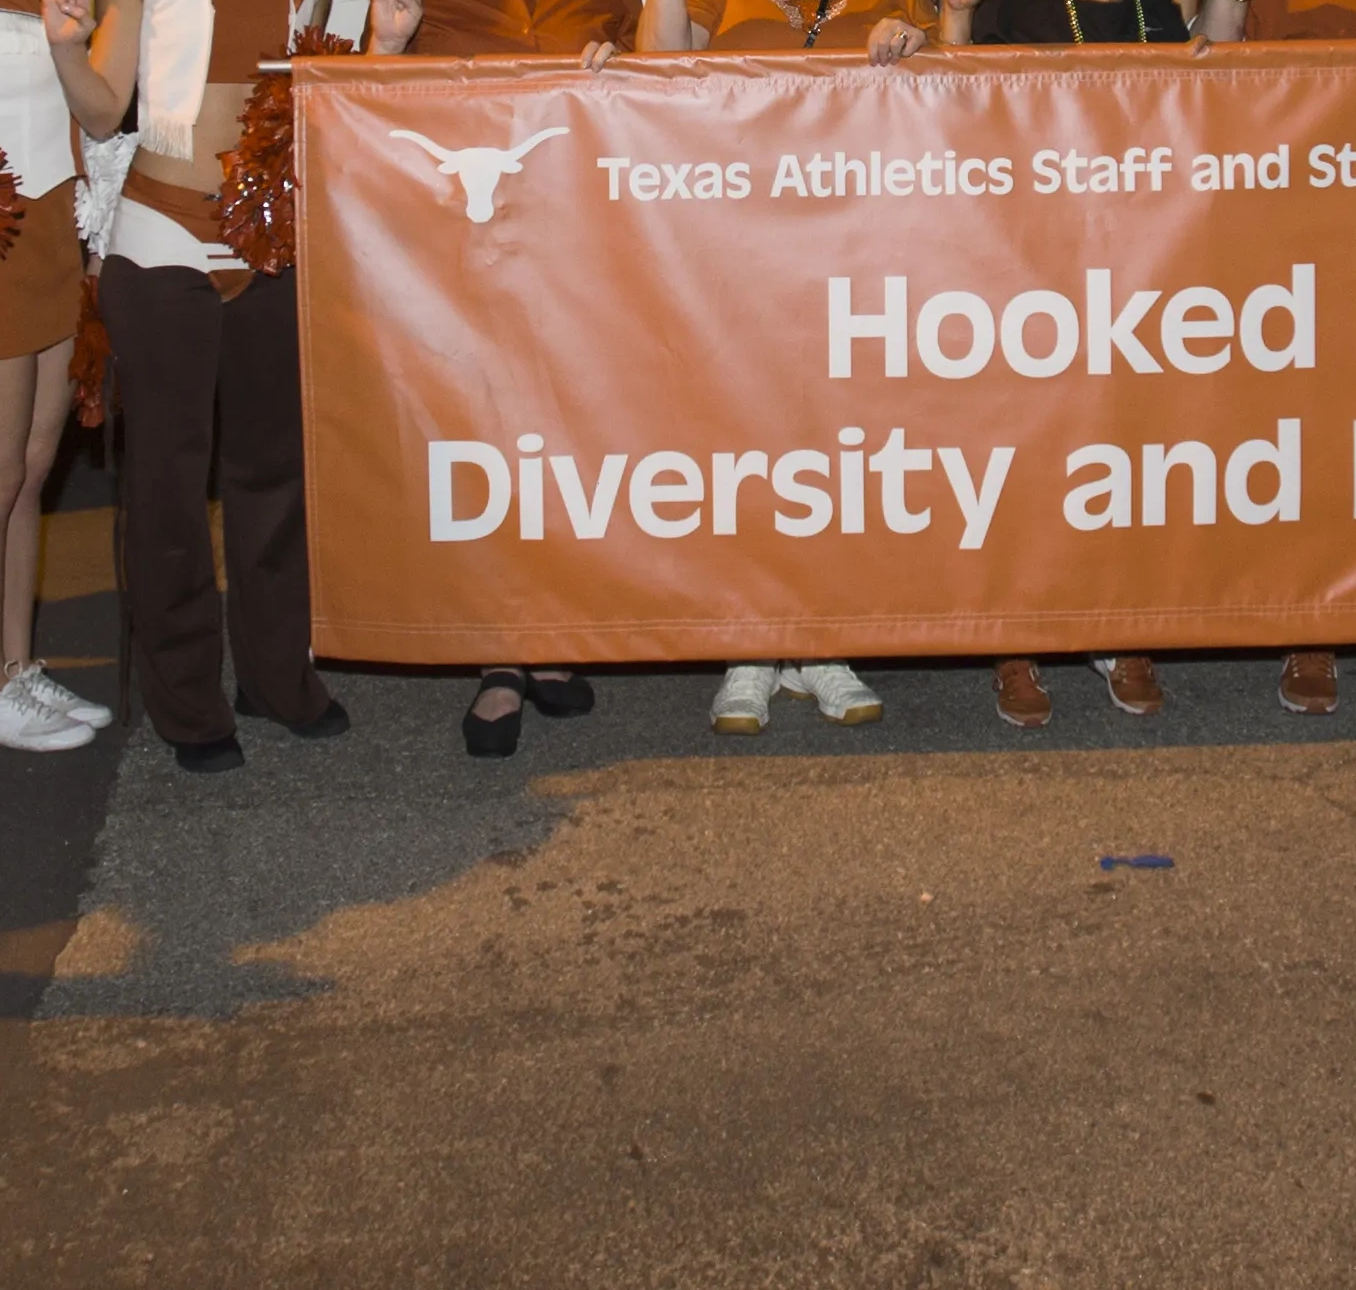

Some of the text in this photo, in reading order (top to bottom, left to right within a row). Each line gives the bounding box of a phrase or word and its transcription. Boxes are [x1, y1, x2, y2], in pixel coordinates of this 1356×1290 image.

[597, 156, 752, 202] Texas
[770, 150, 1015, 198] Athletics
[1032, 146, 1174, 194] Staff
[1191, 144, 1291, 192] and
[827, 263, 1316, 379] Hooked
[428, 426, 1017, 550] Diversity
[1062, 418, 1302, 531] and
